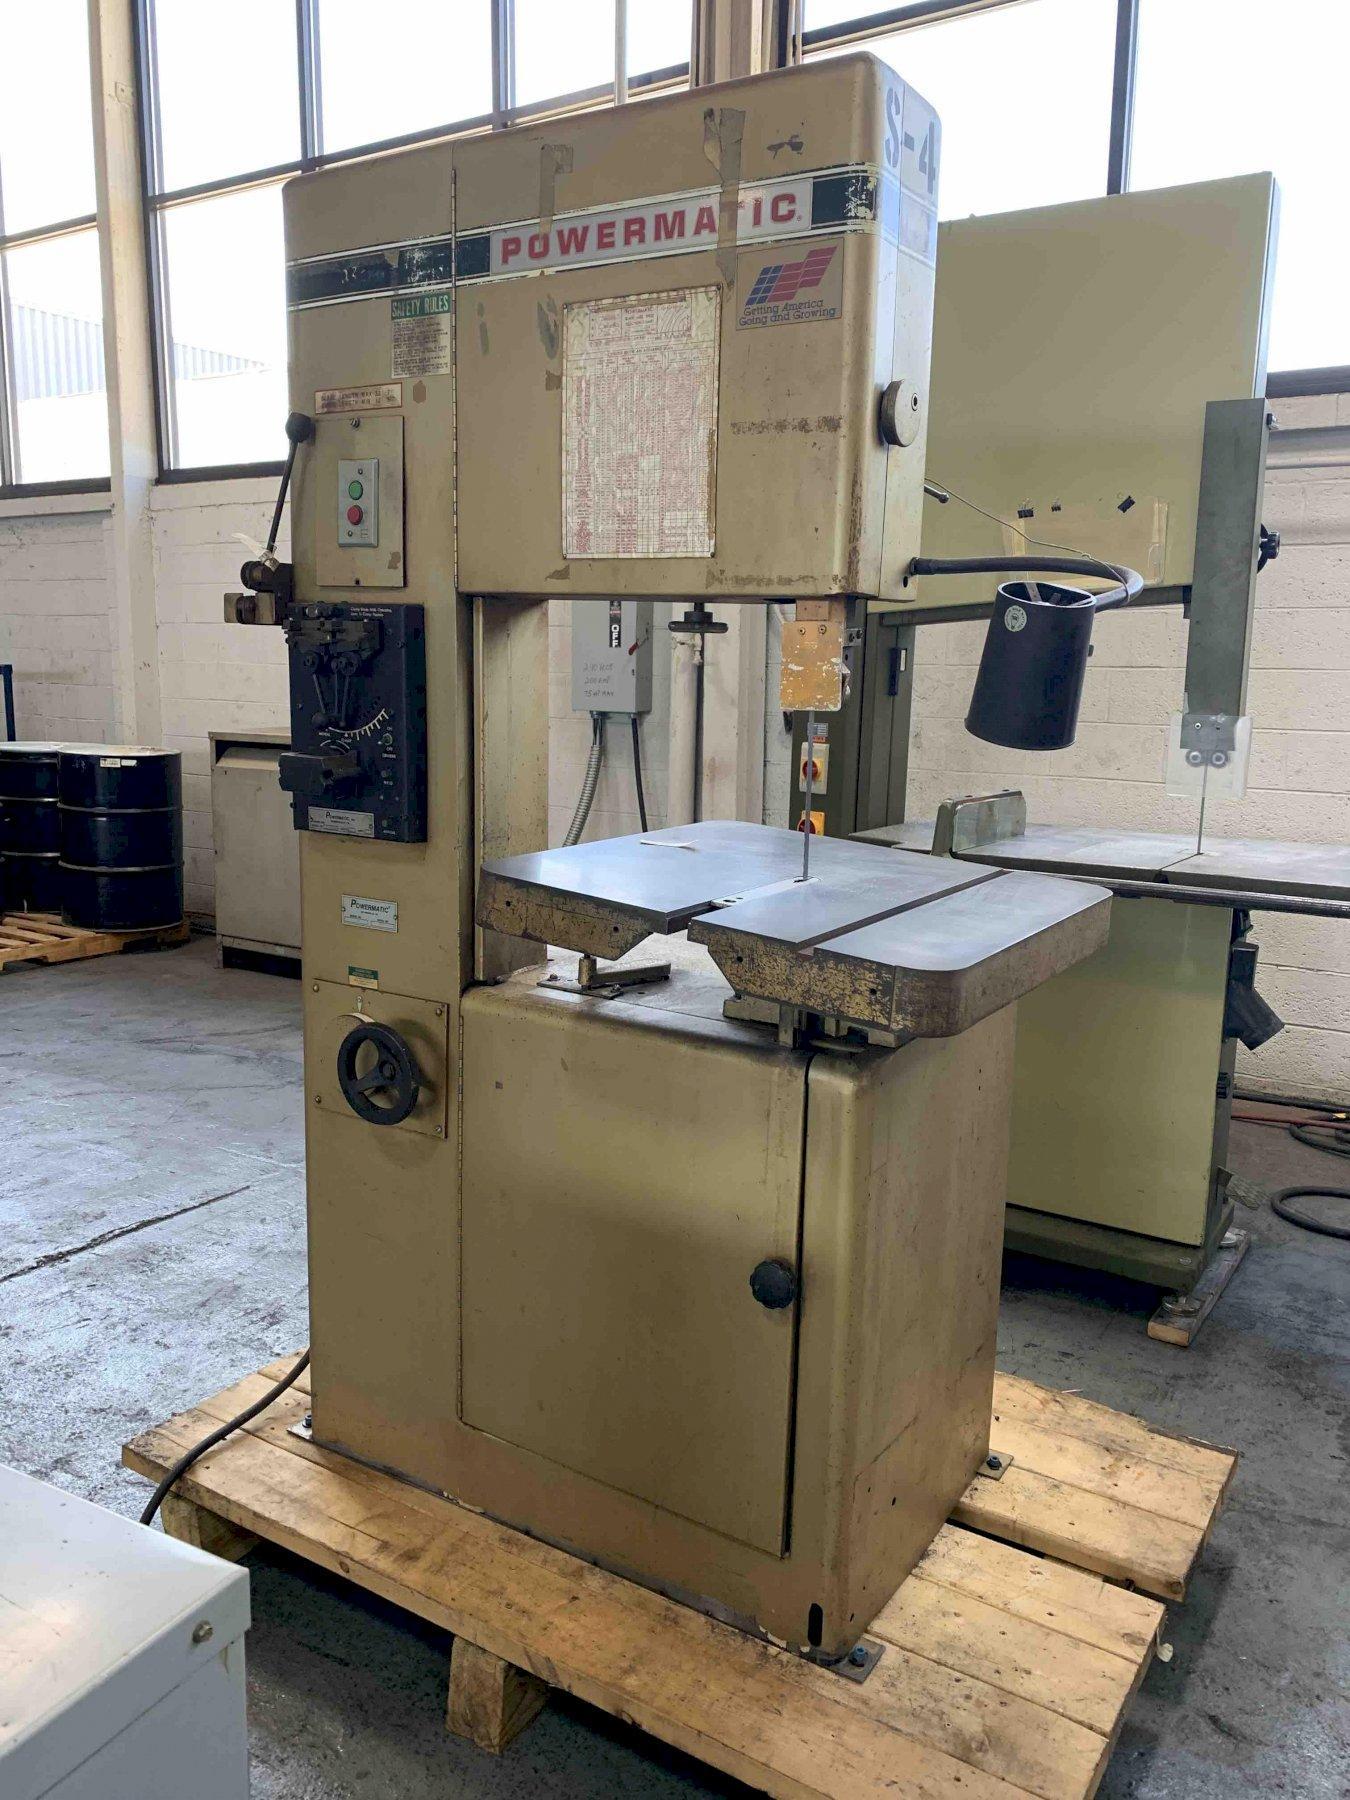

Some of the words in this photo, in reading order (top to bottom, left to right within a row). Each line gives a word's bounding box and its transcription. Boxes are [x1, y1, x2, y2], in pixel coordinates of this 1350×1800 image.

[885, 88, 935, 195] S-4
[501, 193, 797, 265] POWERMAIC
[392, 299, 421, 317] SAFETY
[424, 295, 449, 314] RULES
[739, 315, 768, 326] Going
[770, 311, 790, 322] and
[793, 308, 836, 319] Growing
[743, 305, 780, 316] Getting
[782, 299, 824, 311] America
[611, 624, 620, 648] OFF
[350, 899, 389, 914] POWERMATIC
